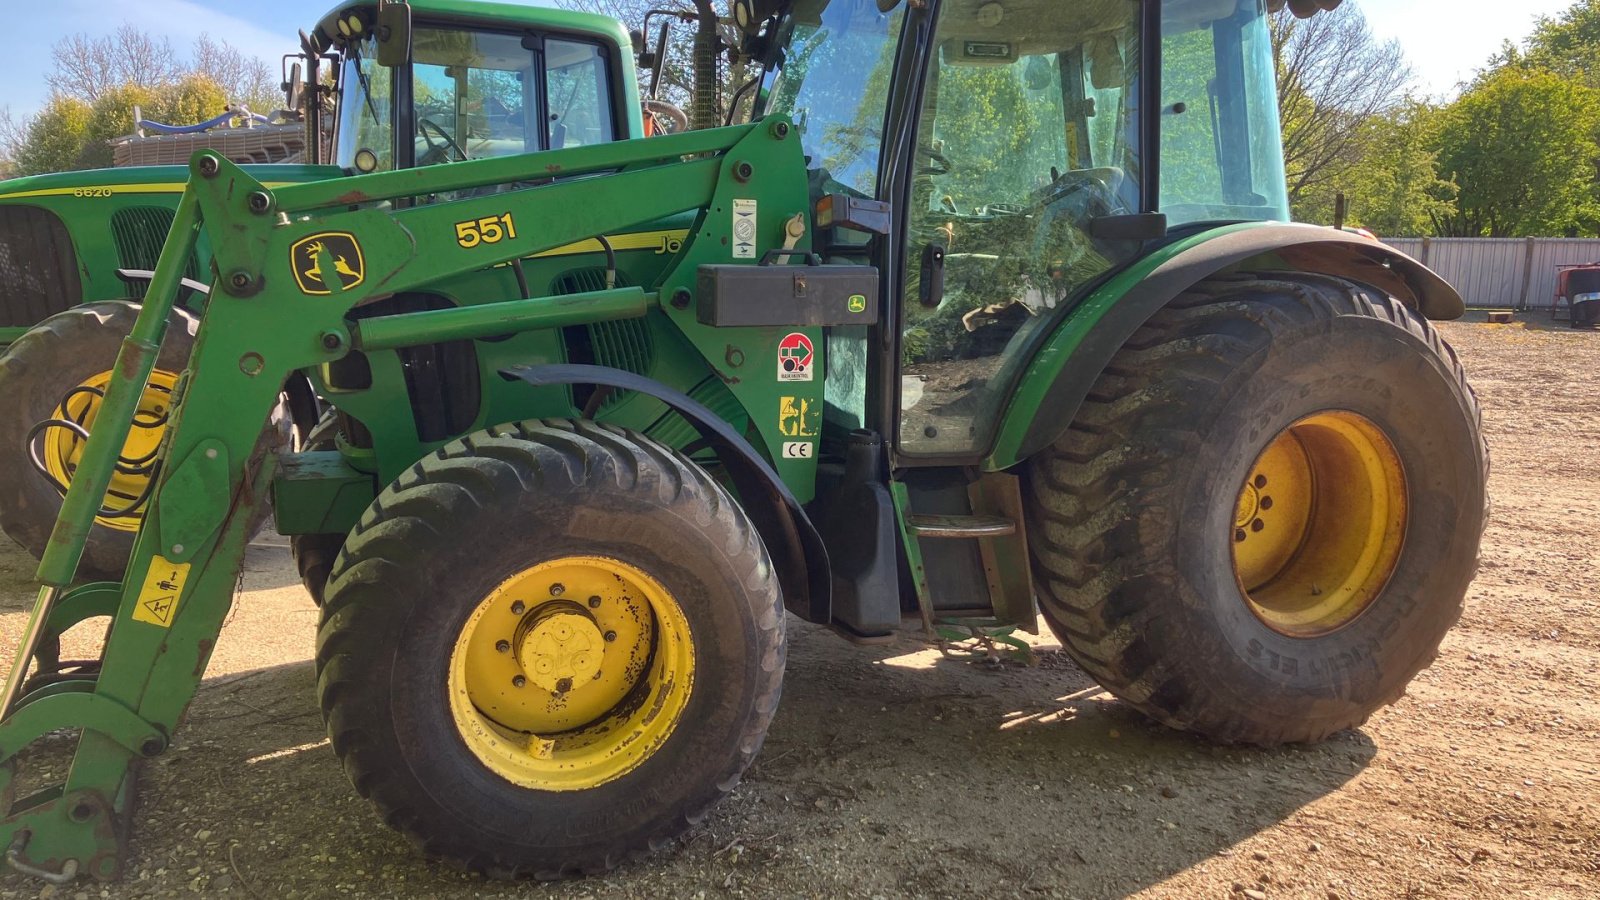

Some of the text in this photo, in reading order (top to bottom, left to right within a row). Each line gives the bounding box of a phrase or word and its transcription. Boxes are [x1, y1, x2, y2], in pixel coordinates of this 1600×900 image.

[74, 187, 112, 197] 6620
[454, 211, 517, 249] 551
[654, 235, 683, 254] Jo
[788, 443, 807, 457] CE
